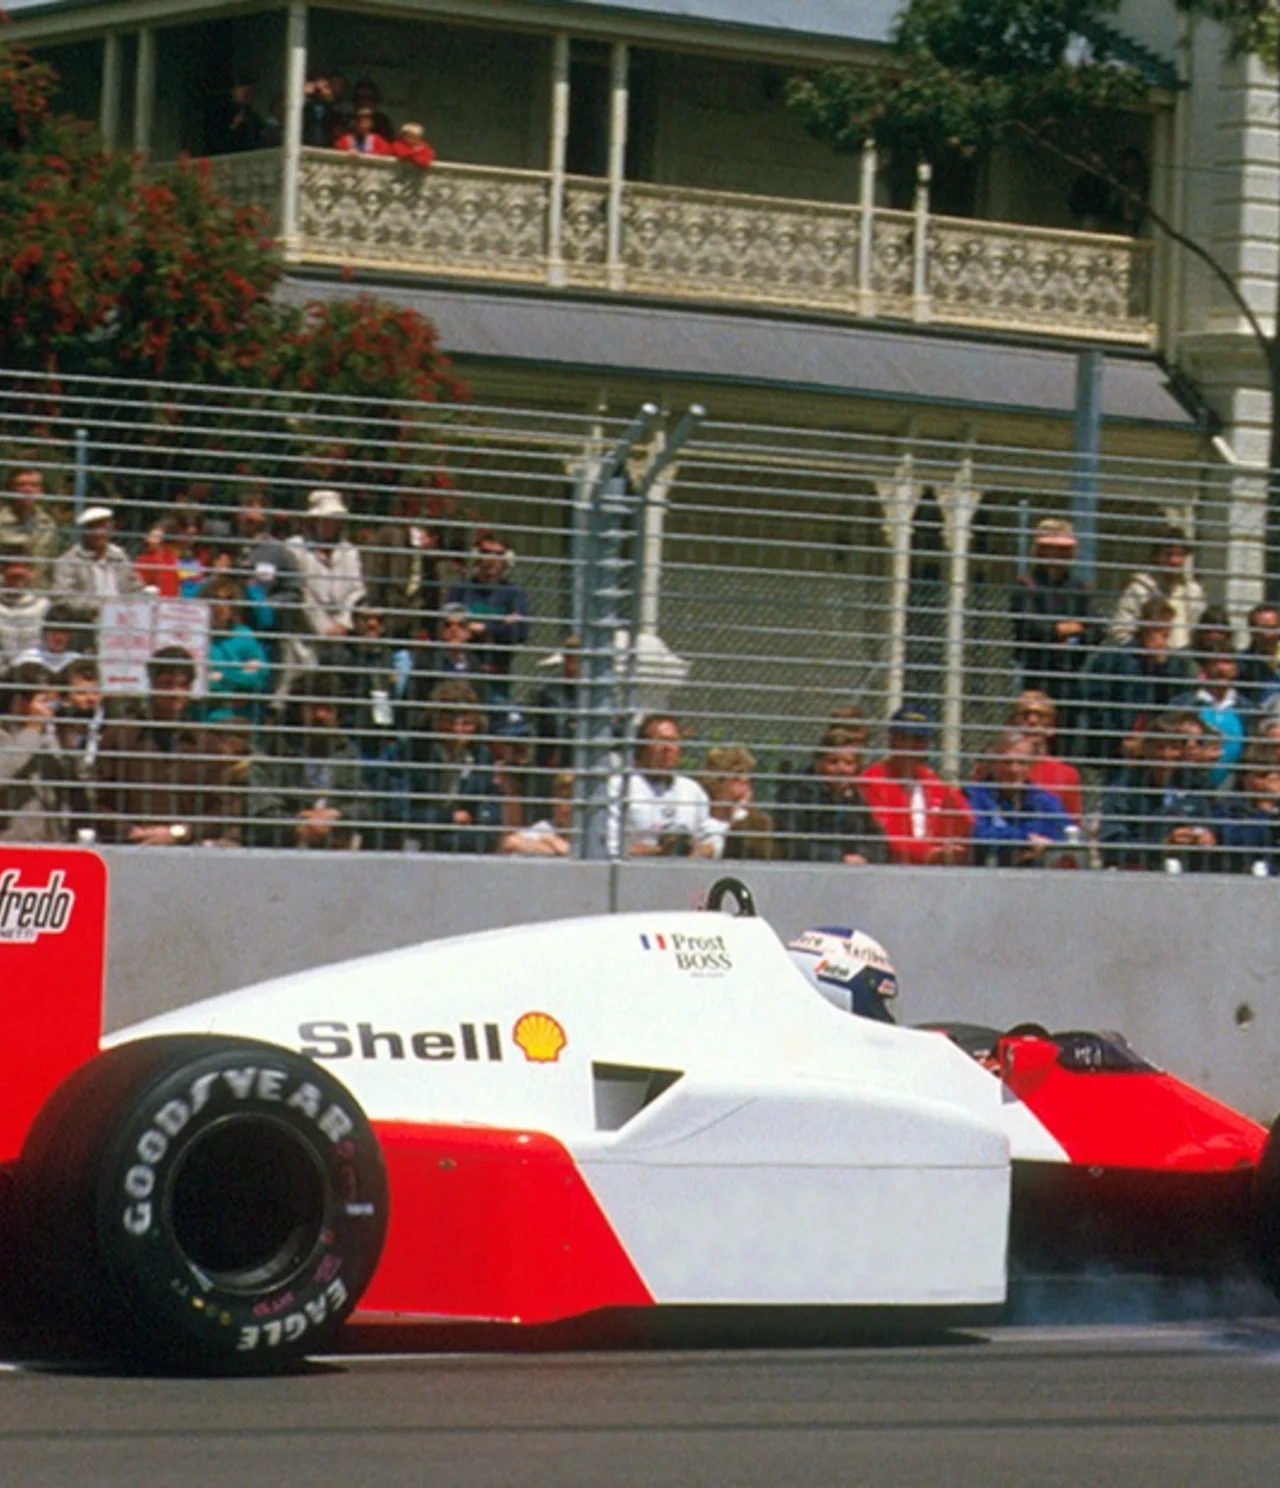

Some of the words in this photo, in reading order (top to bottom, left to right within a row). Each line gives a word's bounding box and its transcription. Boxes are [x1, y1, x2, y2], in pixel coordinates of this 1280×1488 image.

[671, 932, 727, 951] Prost
[676, 953, 733, 971] BOSS
[297, 1020, 503, 1062] Shell
[123, 1066, 354, 1236] GOODYEAR
[236, 1278, 349, 1350] EAGLE
